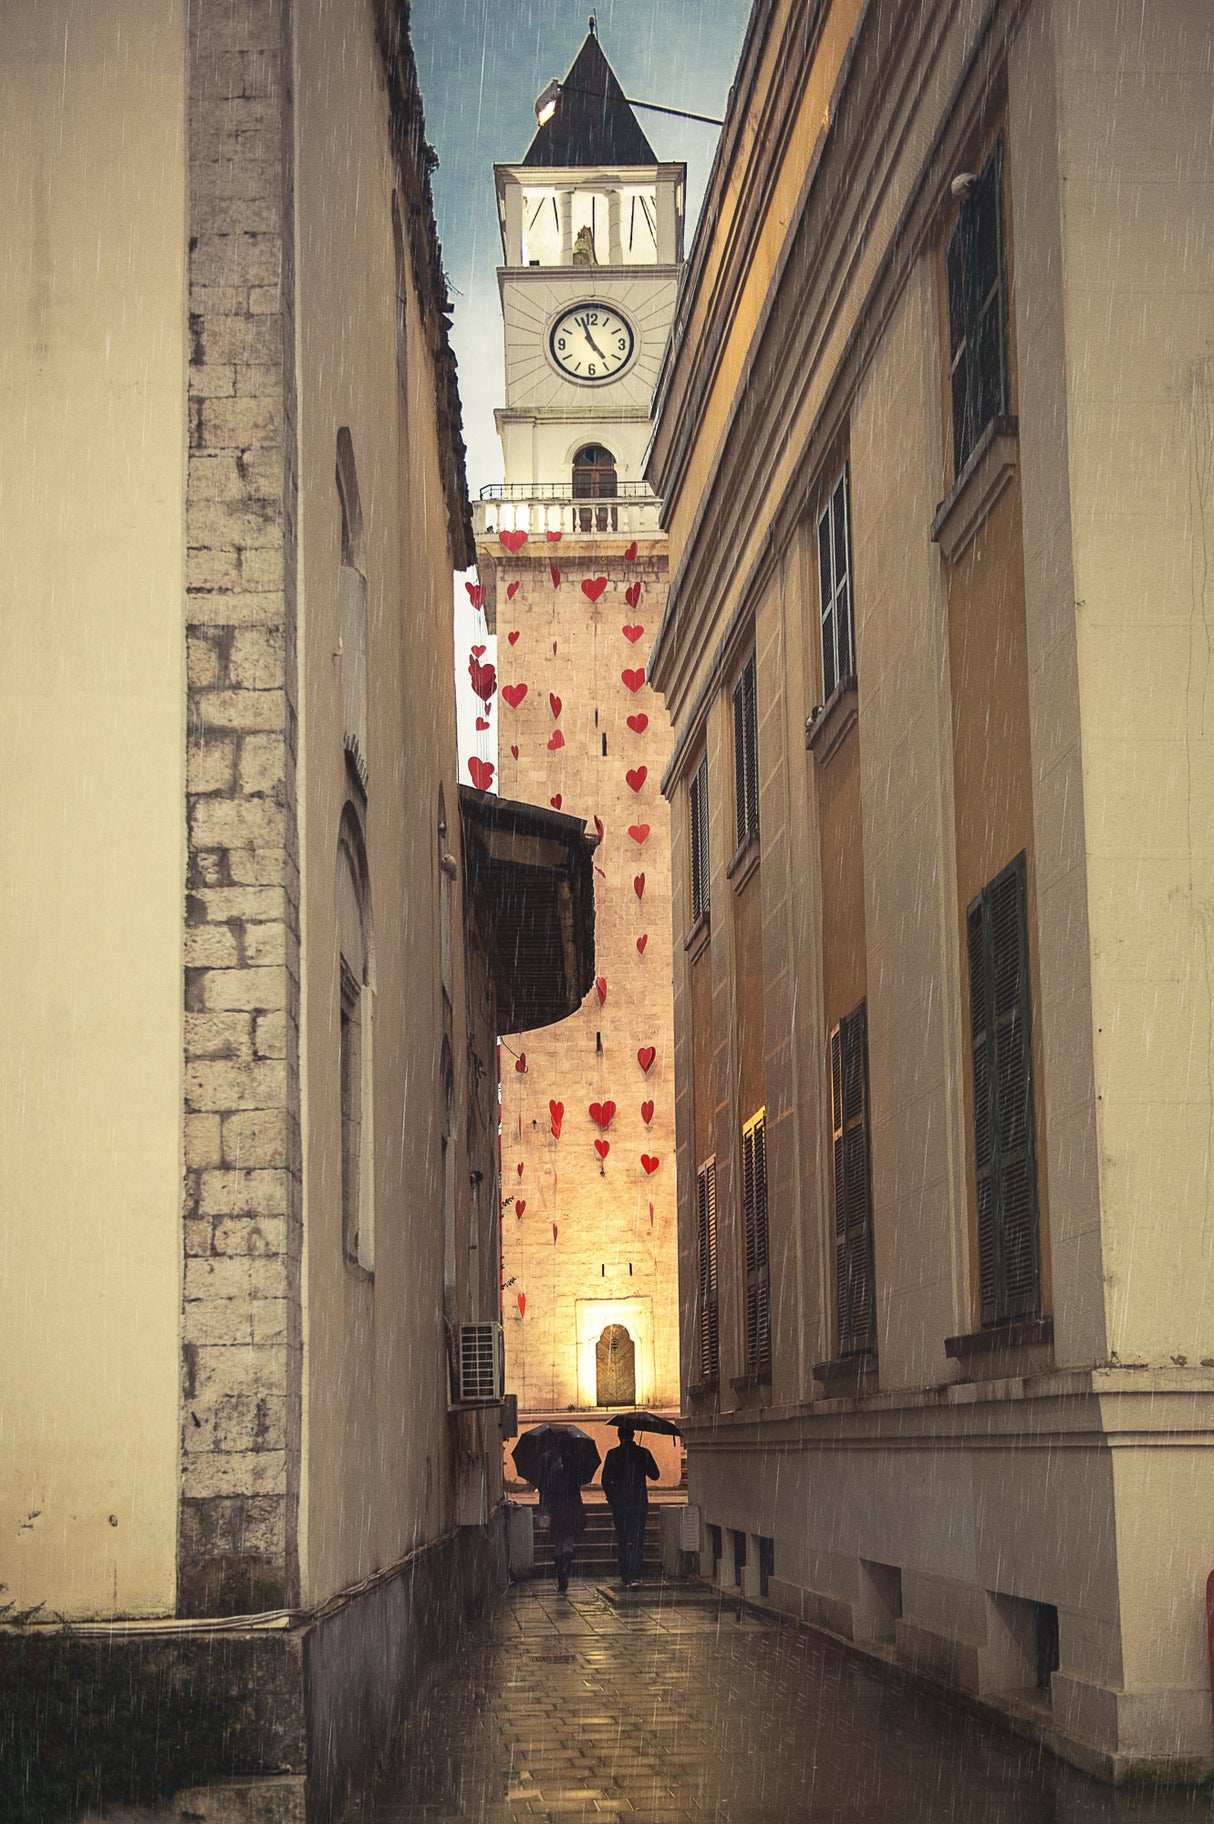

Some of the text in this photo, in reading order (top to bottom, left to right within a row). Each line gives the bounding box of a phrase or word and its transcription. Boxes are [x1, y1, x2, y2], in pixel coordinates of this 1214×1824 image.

[585, 313, 598, 325] 12
[558, 338, 566, 350] 9
[618, 338, 626, 351] 3
[588, 363, 596, 375] 6
